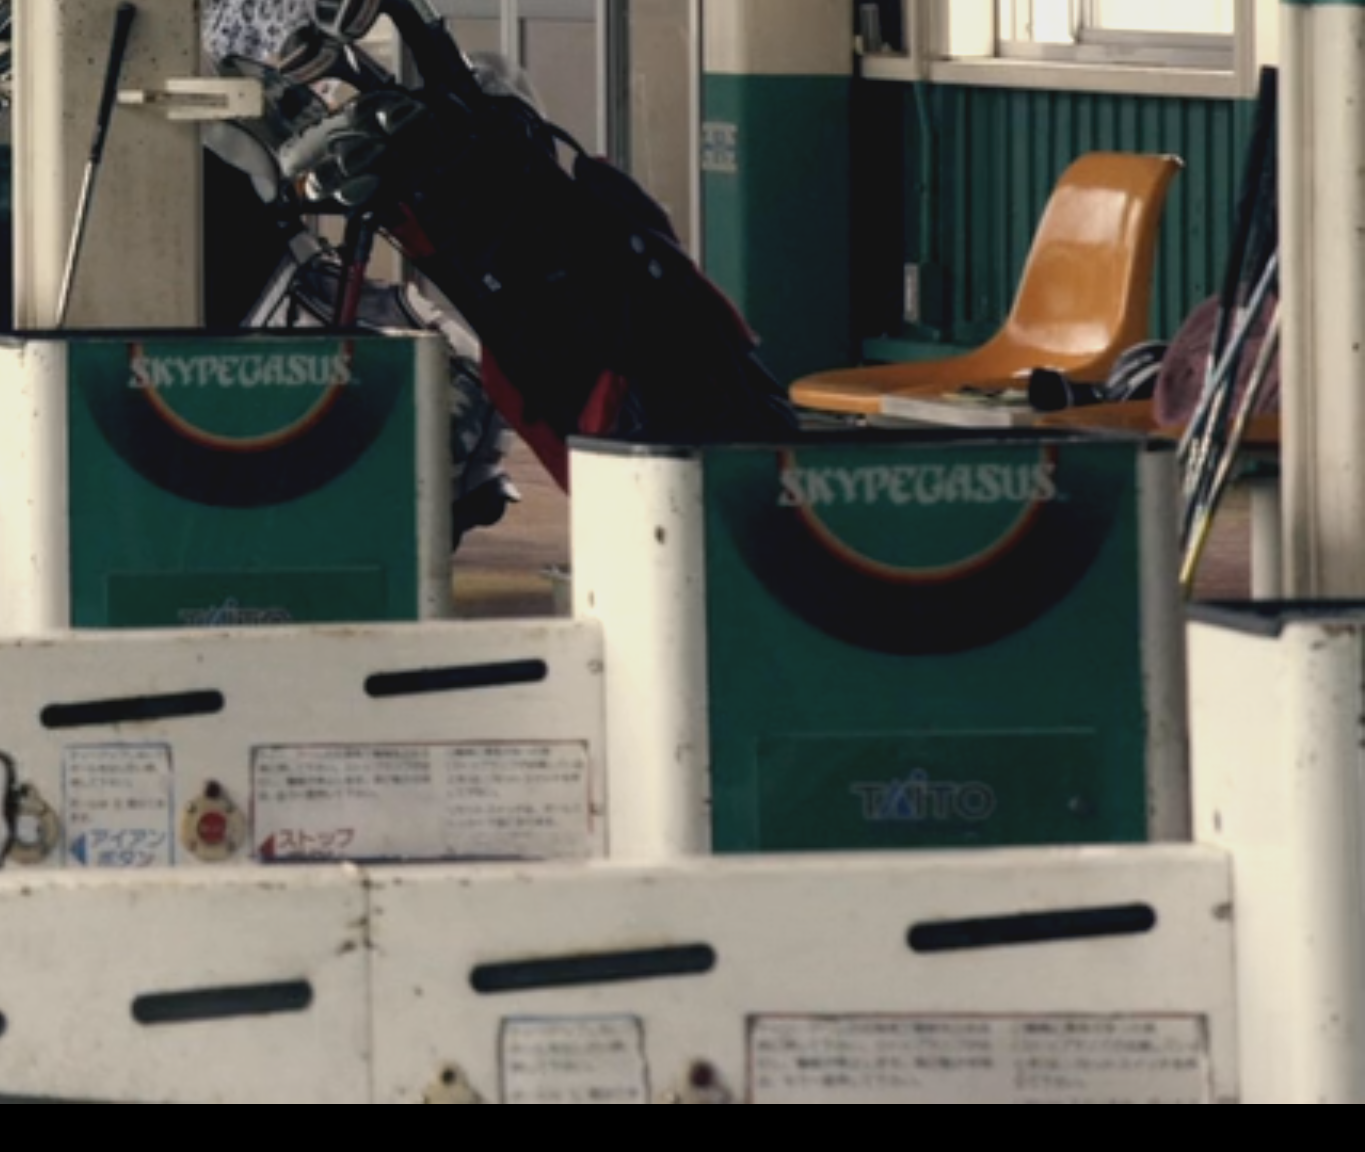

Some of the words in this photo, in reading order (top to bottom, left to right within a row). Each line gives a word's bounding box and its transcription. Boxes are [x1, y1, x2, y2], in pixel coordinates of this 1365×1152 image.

[125, 353, 350, 389] SKYPEGASUS
[777, 463, 1055, 507] SKYPEGASUS
[848, 767, 996, 821] TAITO
[89, 828, 165, 849] アイアン
[276, 827, 356, 850] ストップ
